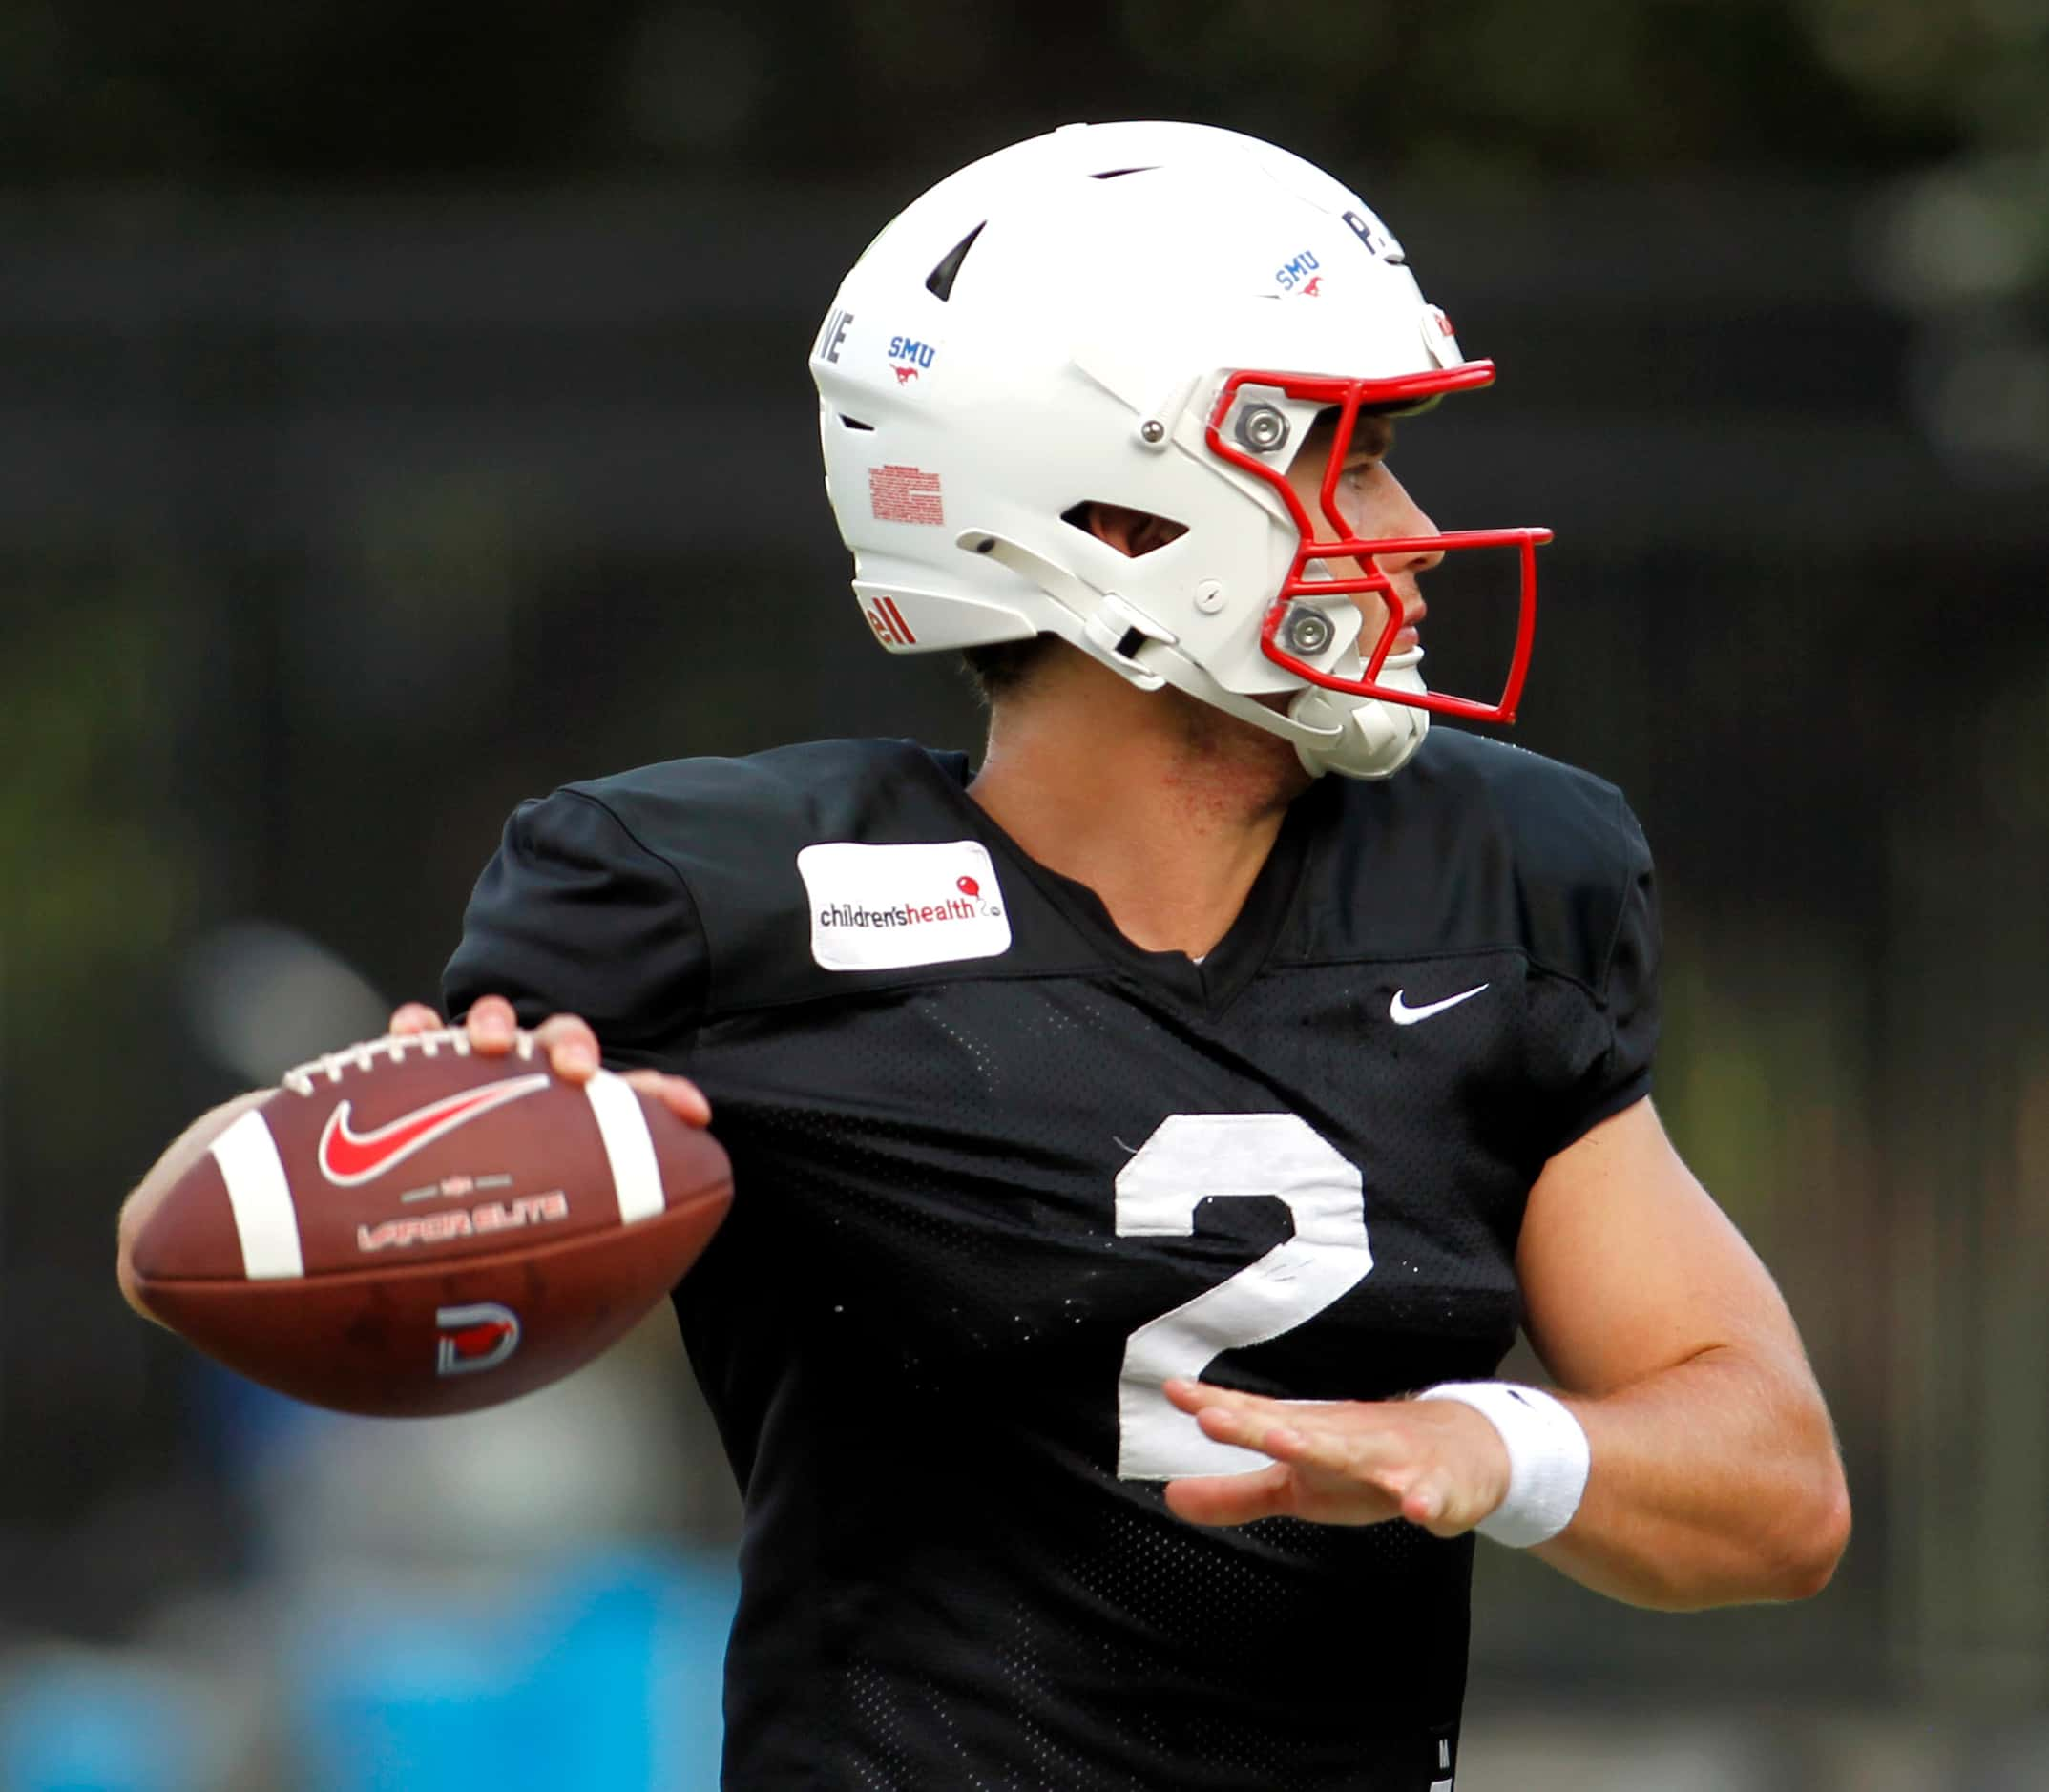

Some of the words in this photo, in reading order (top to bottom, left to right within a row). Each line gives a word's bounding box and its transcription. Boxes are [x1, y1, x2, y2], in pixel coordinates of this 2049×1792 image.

[1275, 250, 1321, 291] SMU
[888, 335, 935, 369] SMU
[471, 1190, 569, 1234] ELITE
[1115, 1112, 1374, 1482] 2
